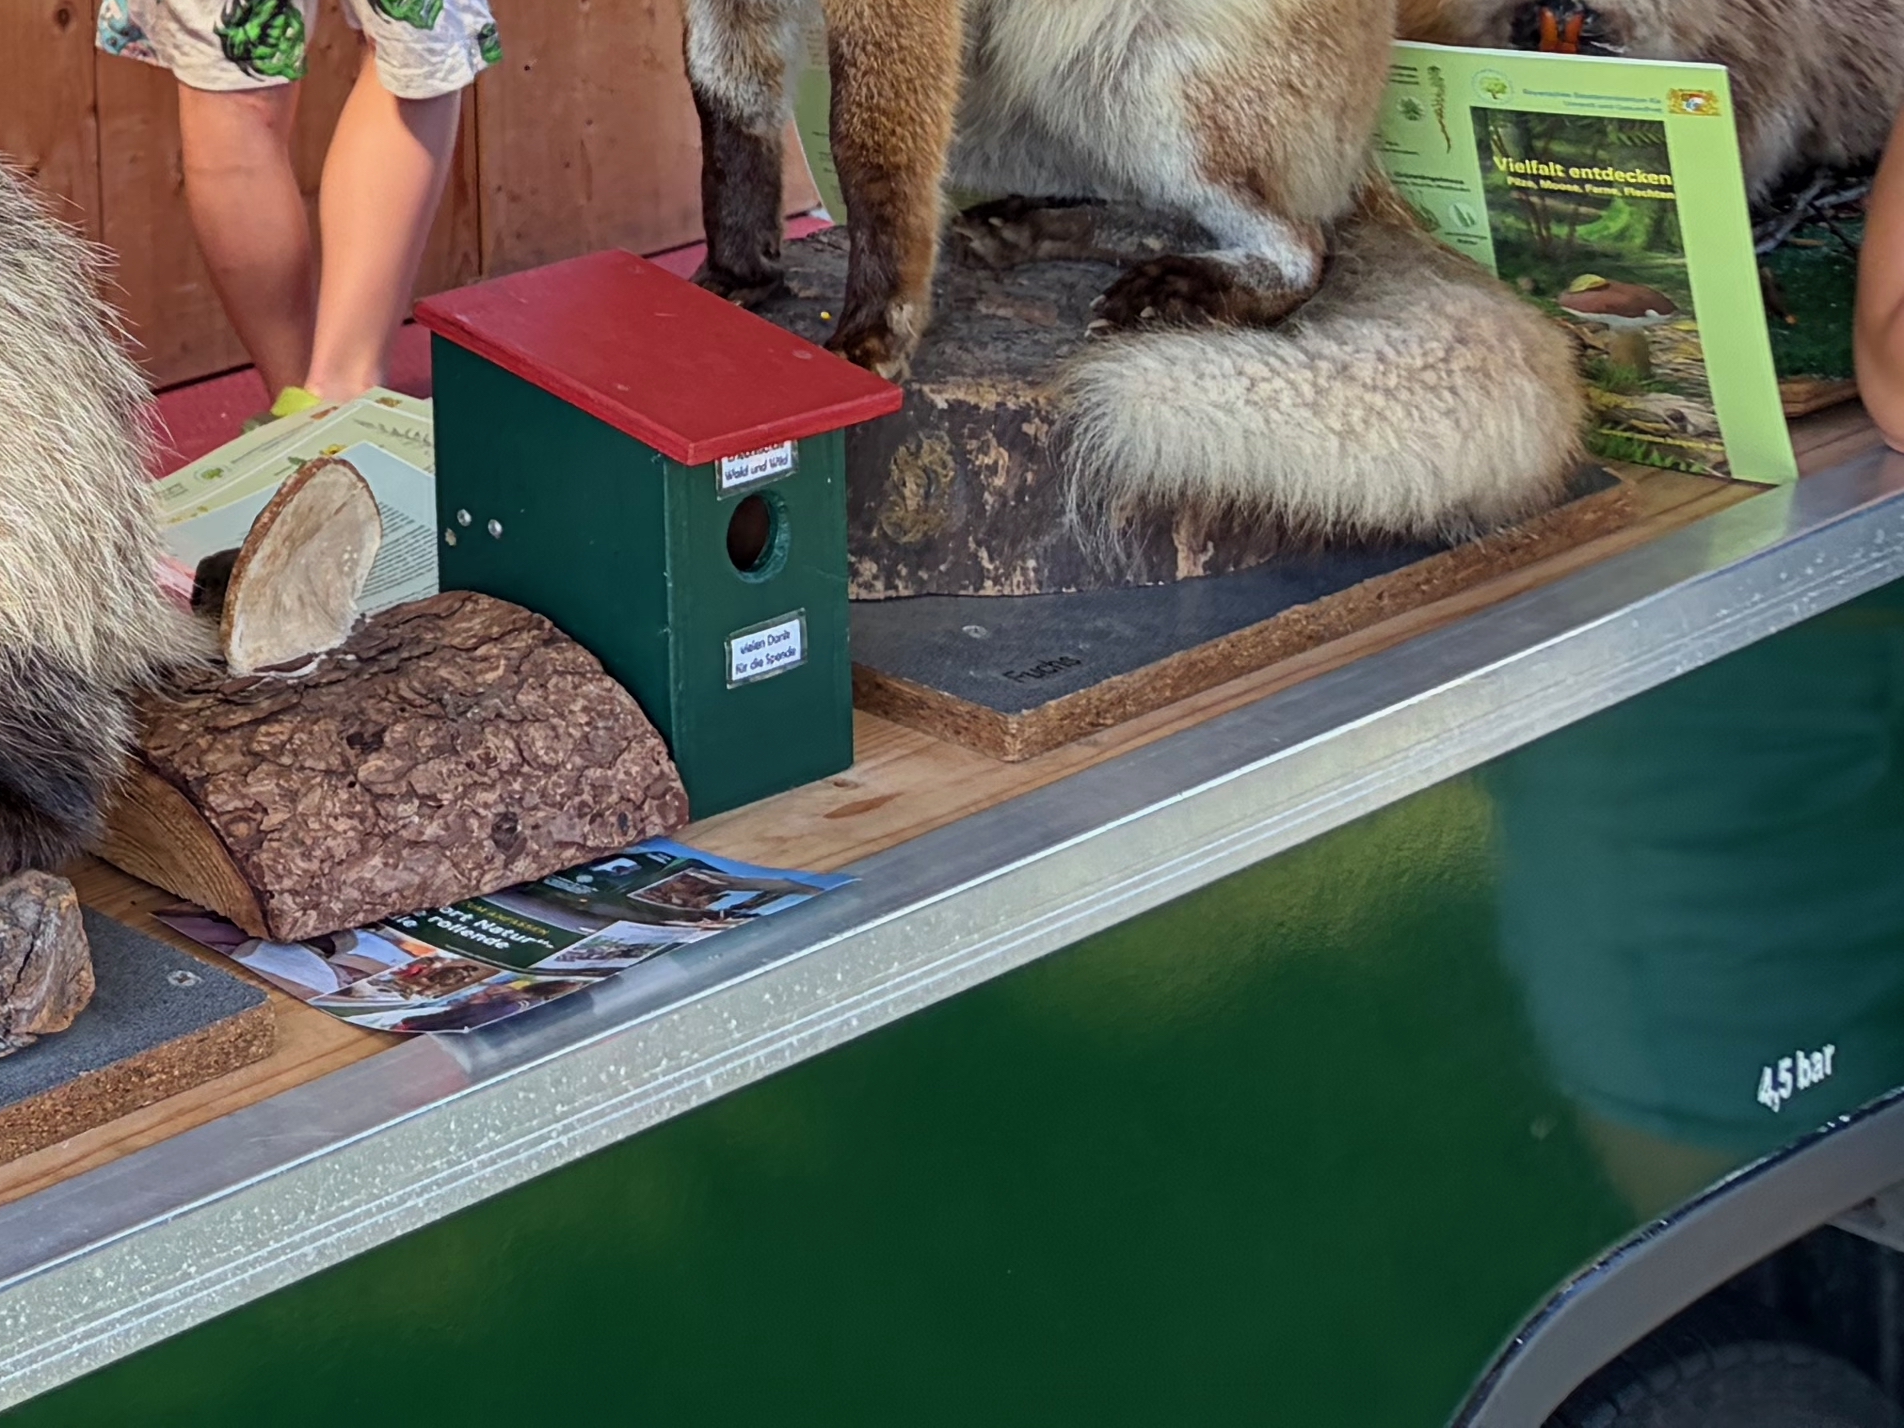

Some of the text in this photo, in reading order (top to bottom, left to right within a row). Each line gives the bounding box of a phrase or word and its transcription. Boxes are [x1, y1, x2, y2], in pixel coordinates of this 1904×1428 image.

[1493, 156, 1673, 186] Vielfalt entdecken
[724, 464, 749, 482] Wald
[750, 459, 768, 475] und
[769, 452, 789, 469] Wild
[767, 629, 791, 646] Dank
[735, 645, 797, 675] für die Spende
[427, 915, 511, 950] rollende
[1756, 1043, 1836, 1113] 4,5 bar
